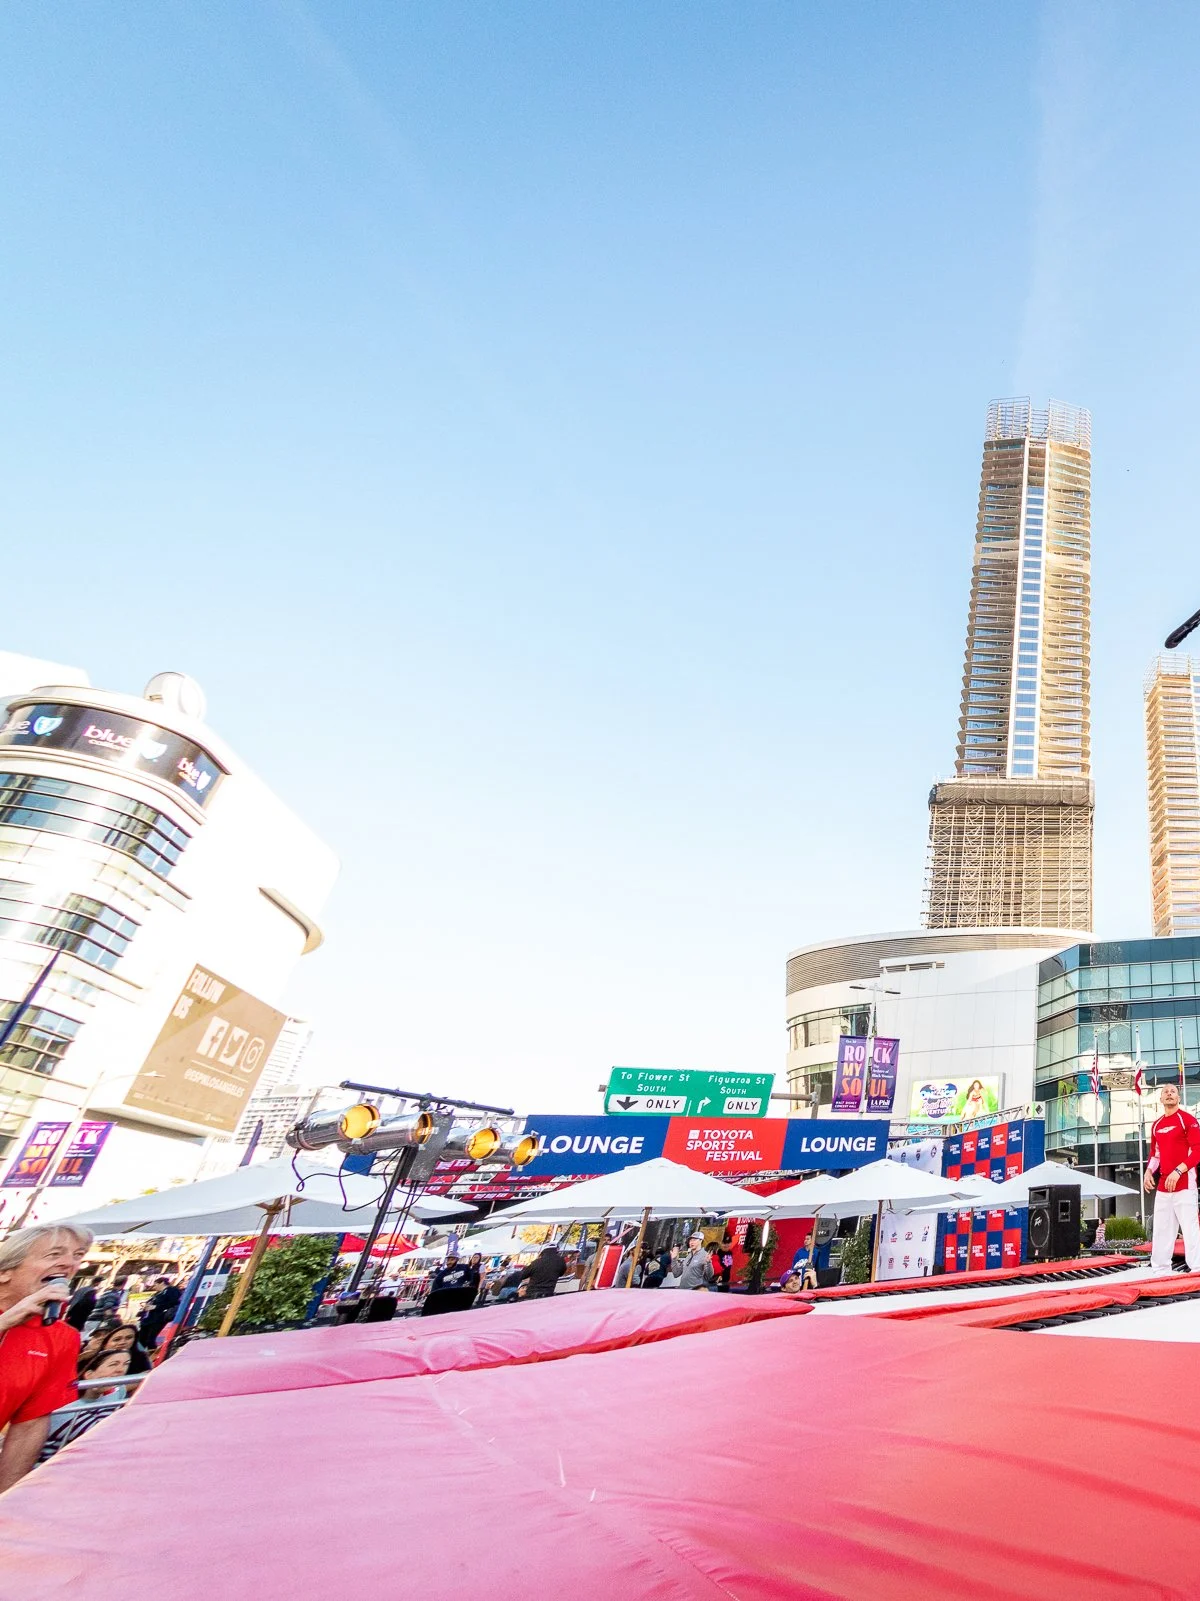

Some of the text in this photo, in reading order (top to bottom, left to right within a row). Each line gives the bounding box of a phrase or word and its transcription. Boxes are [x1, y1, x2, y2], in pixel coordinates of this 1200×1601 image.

[186, 969, 226, 1003] FOLLOW
[172, 994, 194, 1019] US
[842, 1062, 862, 1077] MY
[621, 1072, 690, 1082] To Flower St
[707, 1074, 766, 1085] Figueroa St
[636, 1083, 667, 1093] SOUTH
[720, 1086, 747, 1095] SOUTH
[646, 1099, 681, 1109] ONLY
[727, 1101, 758, 1111] ONLY
[702, 1129, 754, 1140] TOYOTA
[538, 1135, 645, 1154] LOUNGE
[686, 1140, 735, 1151] SPORTS
[801, 1136, 877, 1153] LOUNGE
[705, 1150, 763, 1161] FESTIVAL
